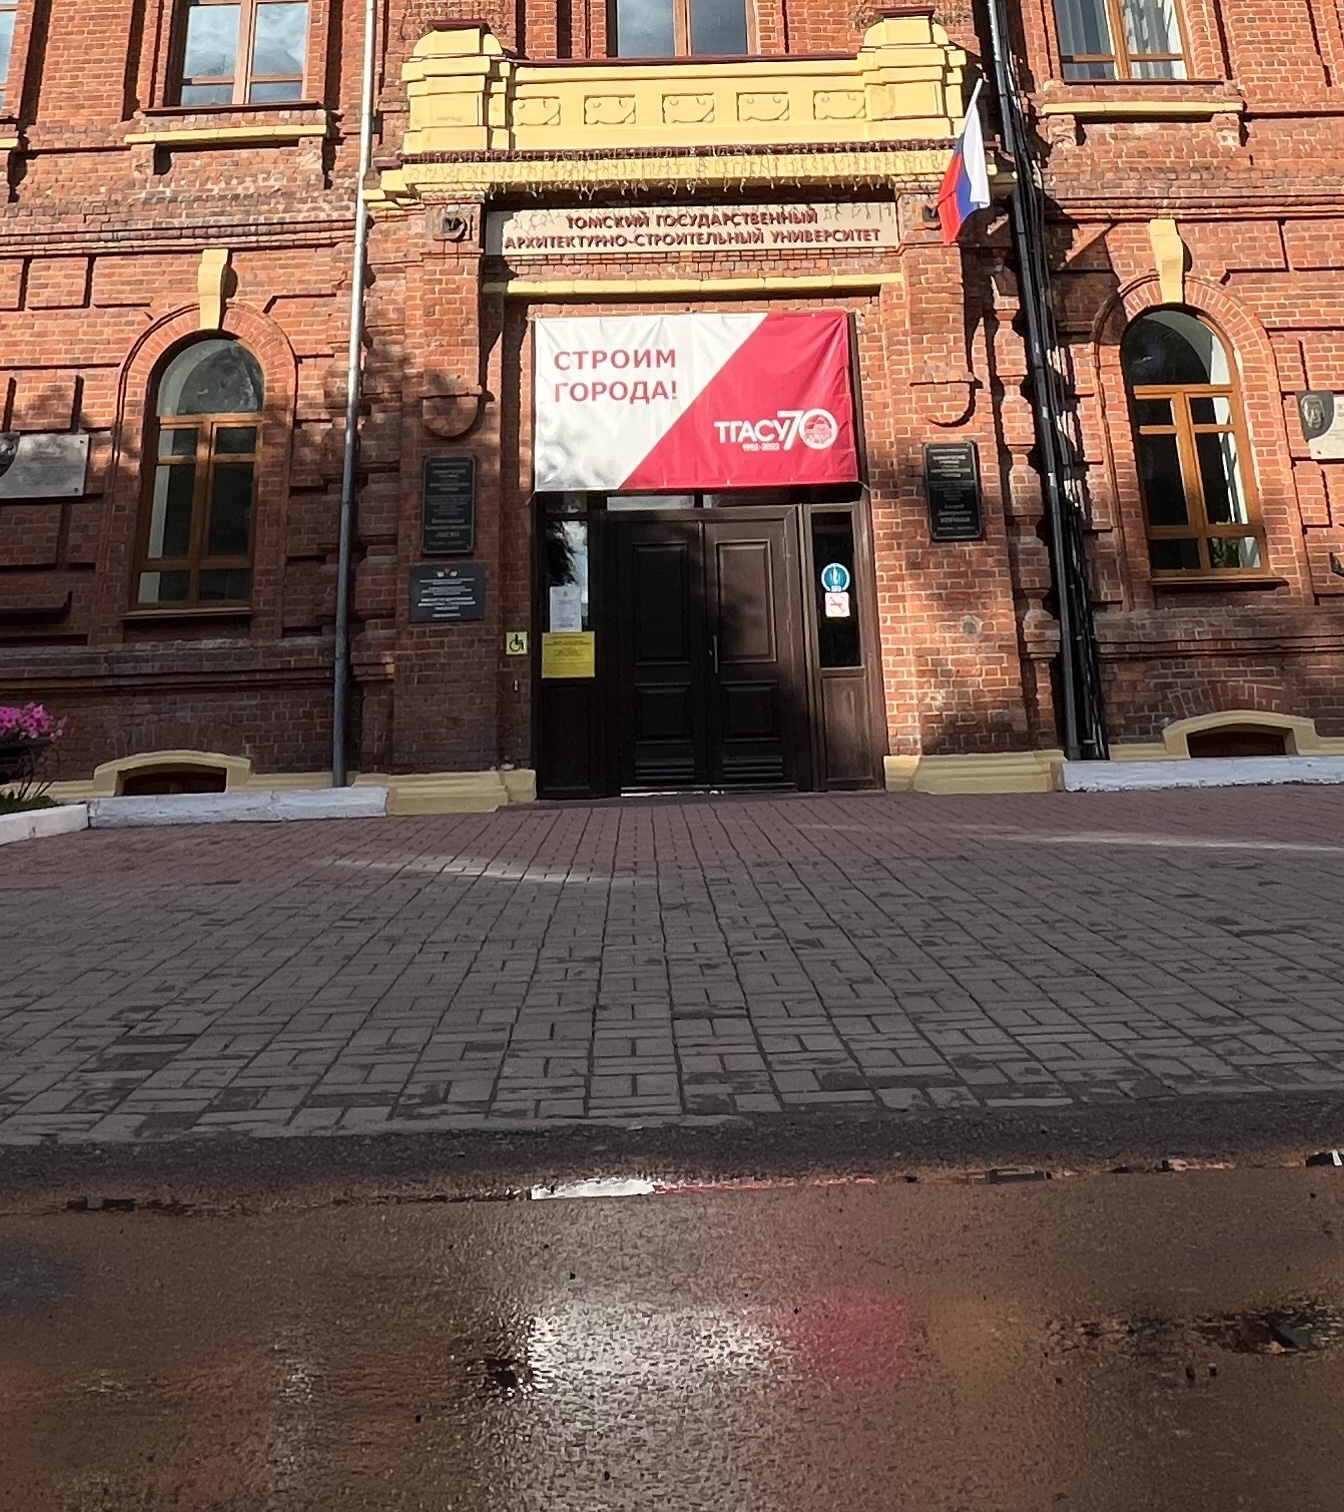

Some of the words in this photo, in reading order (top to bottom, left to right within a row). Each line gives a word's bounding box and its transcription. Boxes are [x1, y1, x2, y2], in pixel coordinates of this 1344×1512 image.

[566, 211, 650, 229] ТОМСКИЙ
[656, 208, 818, 228] ГОСУДАРСТВЕННЫЙ
[504, 231, 764, 249] АРХИТЕКТУРНО-СТРОИТЕЛЬНЫЙ
[770, 228, 881, 244] УНИВЕРСИТЕТ
[554, 349, 676, 370] СТРОИМ
[554, 381, 677, 404] ГОРОДА!
[713, 419, 791, 444] ТГАСУ
